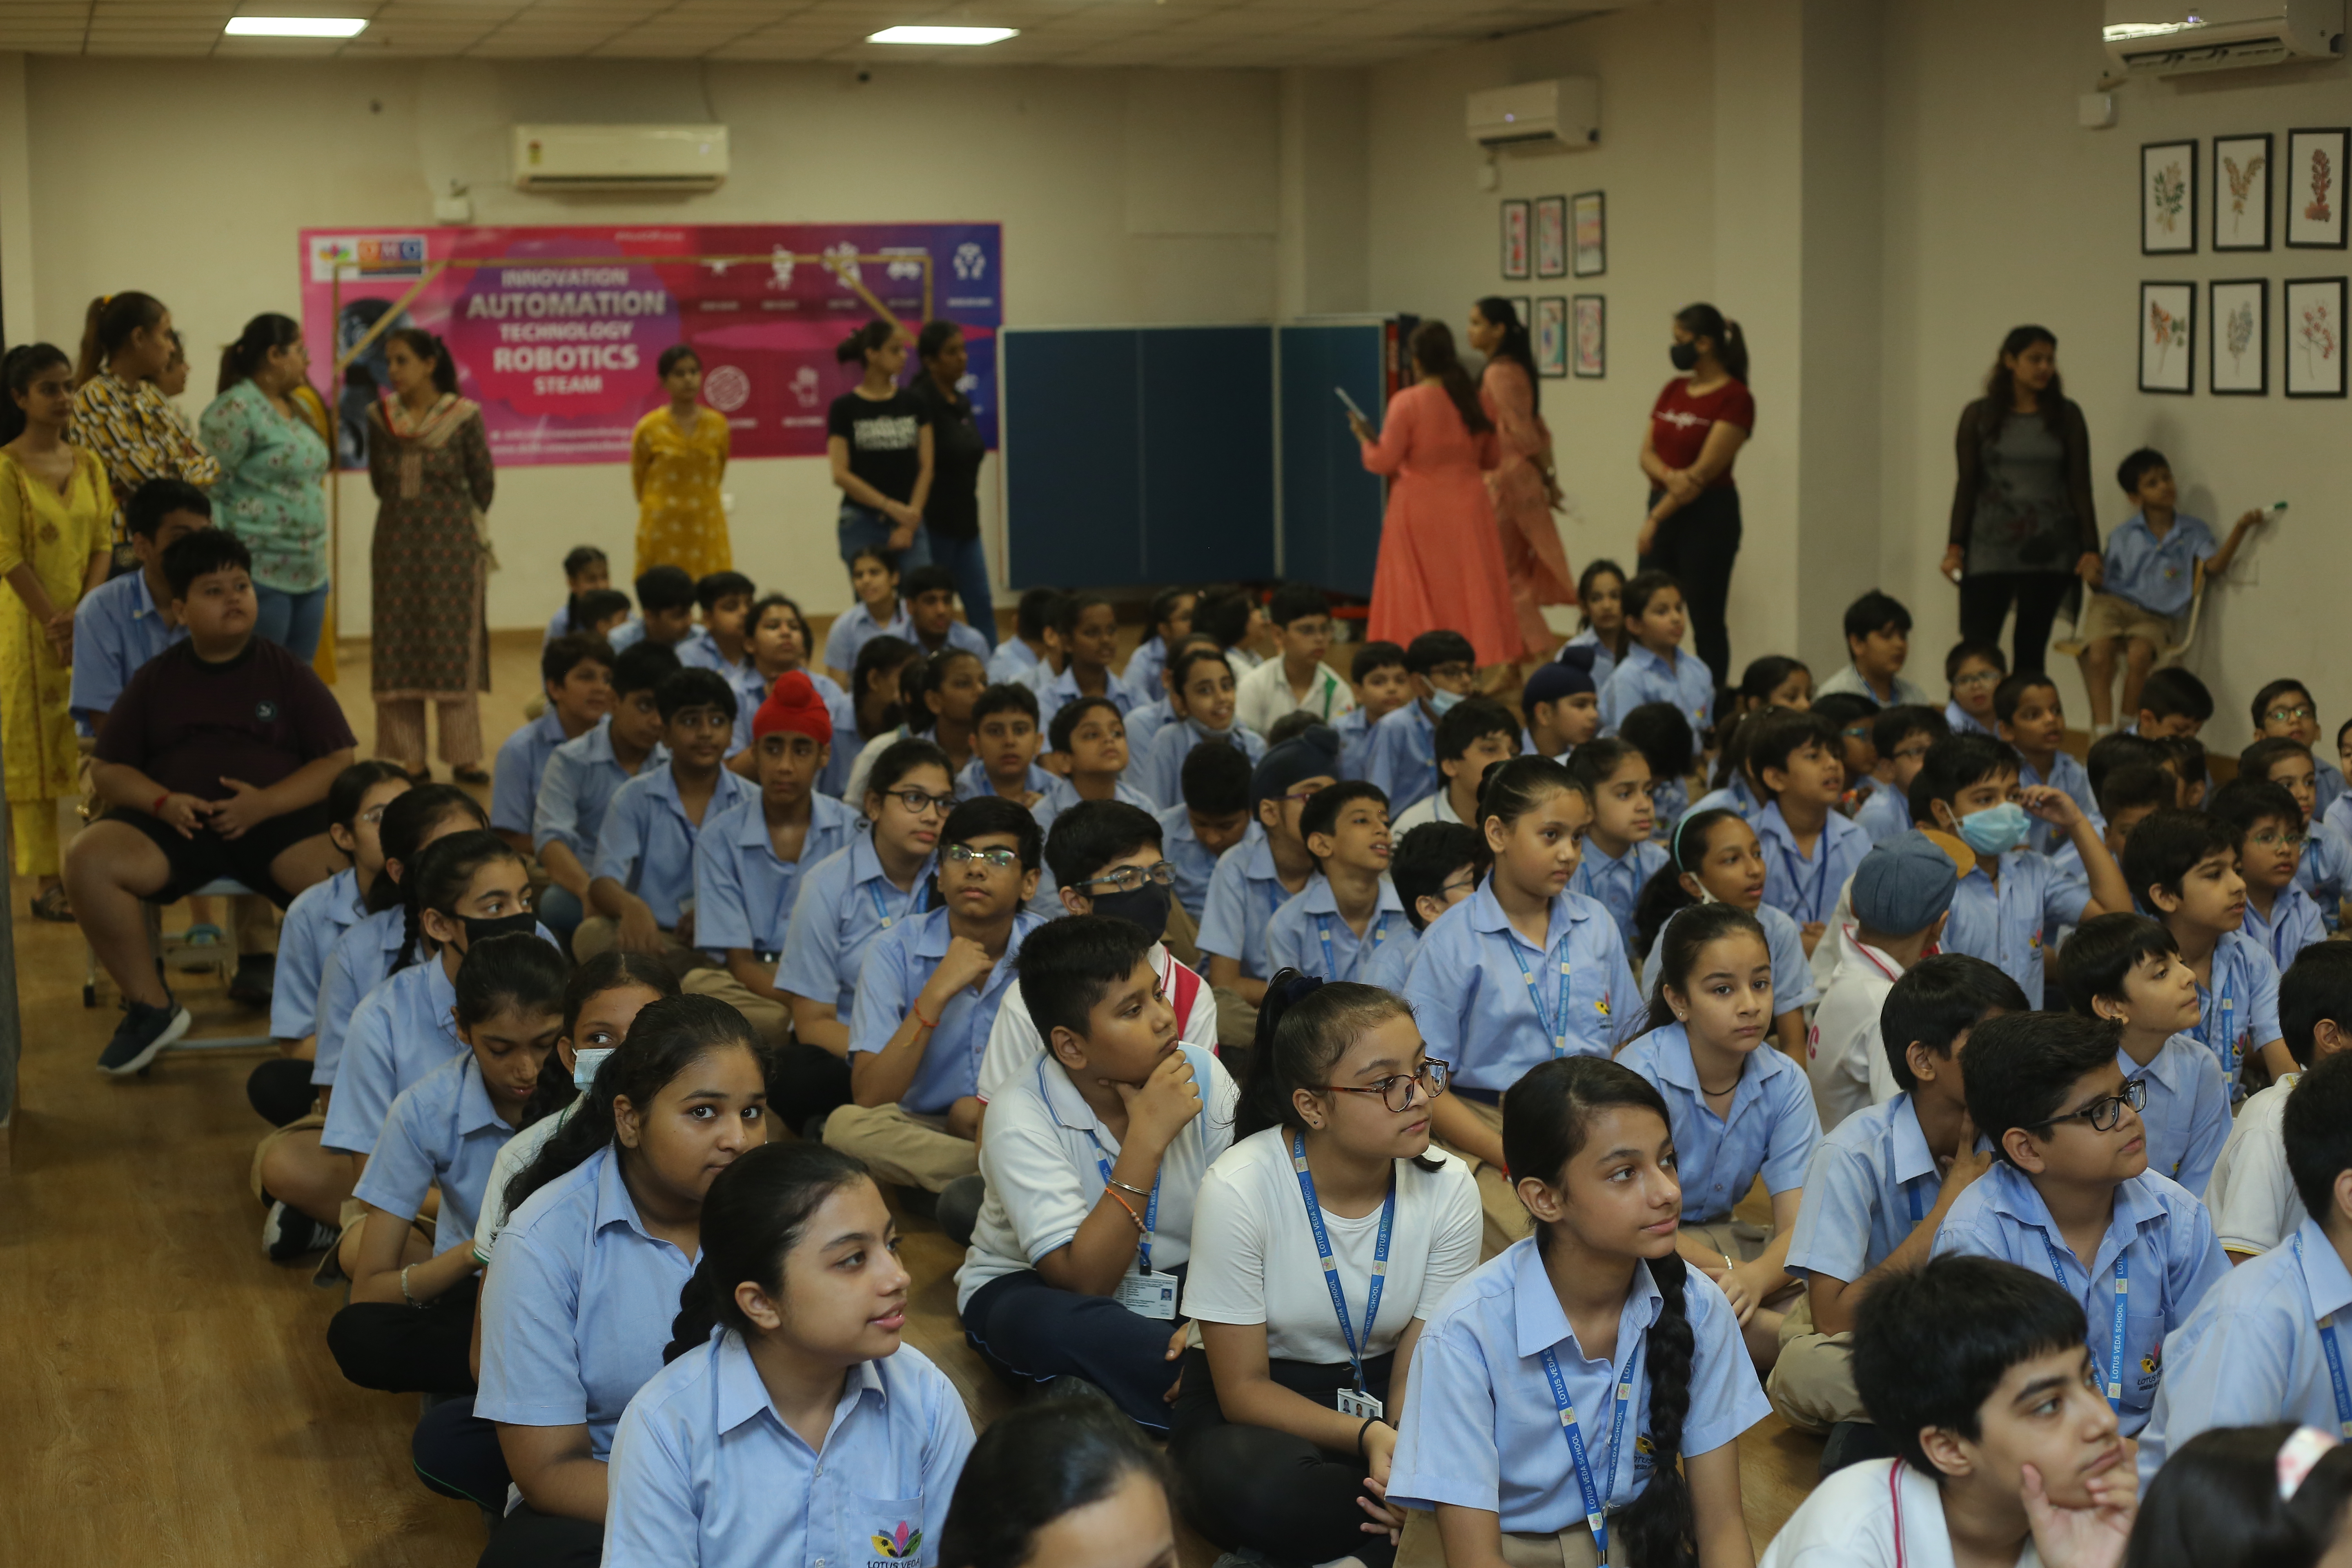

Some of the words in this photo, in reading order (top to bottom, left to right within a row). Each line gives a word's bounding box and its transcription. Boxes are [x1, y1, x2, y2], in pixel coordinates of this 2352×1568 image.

[502, 267, 629, 287] INNOVATION
[466, 290, 667, 318] AUTOMATION
[499, 321, 633, 342] TECHNOLOGY
[493, 344, 639, 372] ROBOTICS
[534, 375, 603, 395] STEAM
[1303, 1181, 1314, 1210] SCHOOL
[1310, 1211, 1320, 1230] VEDA
[1316, 1231, 1327, 1254] LOTUS
[1378, 1234, 1387, 1257] LOTUS
[2049, 1249, 2059, 1269] VEDA
[1329, 1279, 1342, 1307] SCHOOL
[1370, 1284, 1379, 1314] SCHOOL
[1338, 1308, 1347, 1326] VEDA
[1547, 1356, 1558, 1378] VEDA
[1554, 1378, 1568, 1405] LOTUS
[2138, 1375, 2156, 1385] LOTUS
[1614, 1410, 1624, 1444] SCHOOL
[1571, 1432, 1585, 1465] SCHOOL
[1580, 1465, 1590, 1486] VEDA
[1586, 1485, 1597, 1510] LOTUS
[901, 1558, 920, 1568] VEDA
